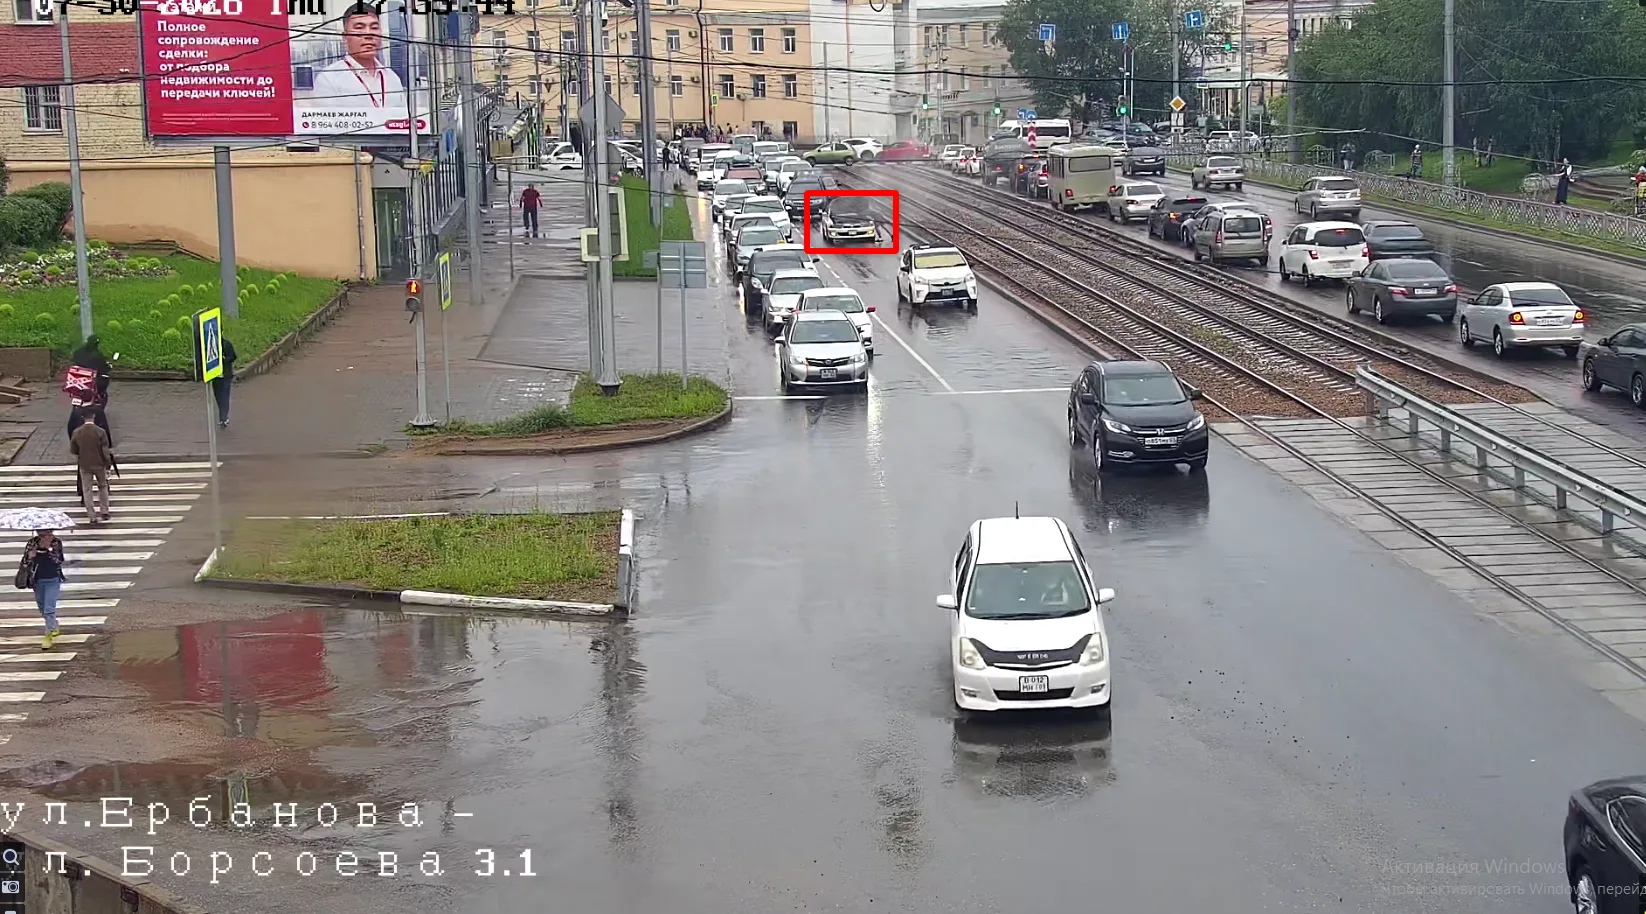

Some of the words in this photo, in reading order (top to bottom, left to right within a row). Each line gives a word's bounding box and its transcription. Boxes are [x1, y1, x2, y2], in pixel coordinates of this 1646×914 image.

[157, 20, 206, 32] Полное
[157, 36, 260, 48] сопровождение
[158, 52, 209, 60] сделки:
[176, 61, 230, 73] подбора
[160, 76, 254, 85] недвижимости
[256, 76, 273, 86] до
[161, 90, 220, 100] передачи
[223, 86, 276, 98] ключей!
[311, 121, 317, 129] 8
[317, 121, 333, 129] 964
[334, 121, 374, 129] 408-02-52
